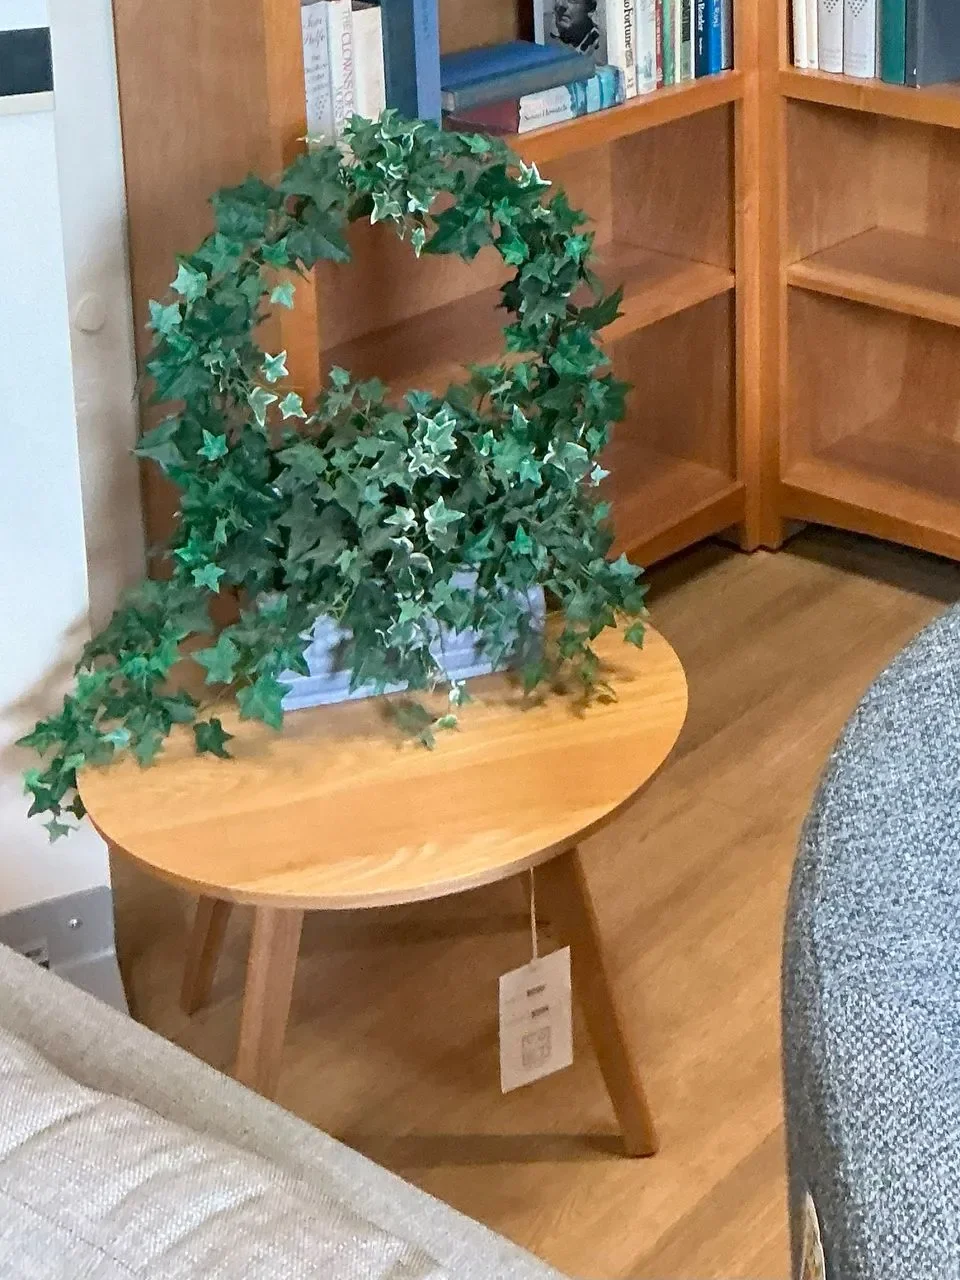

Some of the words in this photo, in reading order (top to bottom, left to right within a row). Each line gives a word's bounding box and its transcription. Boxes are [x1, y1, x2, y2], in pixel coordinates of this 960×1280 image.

[623, 7, 634, 49] Fortune
[697, 3, 706, 32] Reader
[341, 32, 352, 90] CLOWNS
